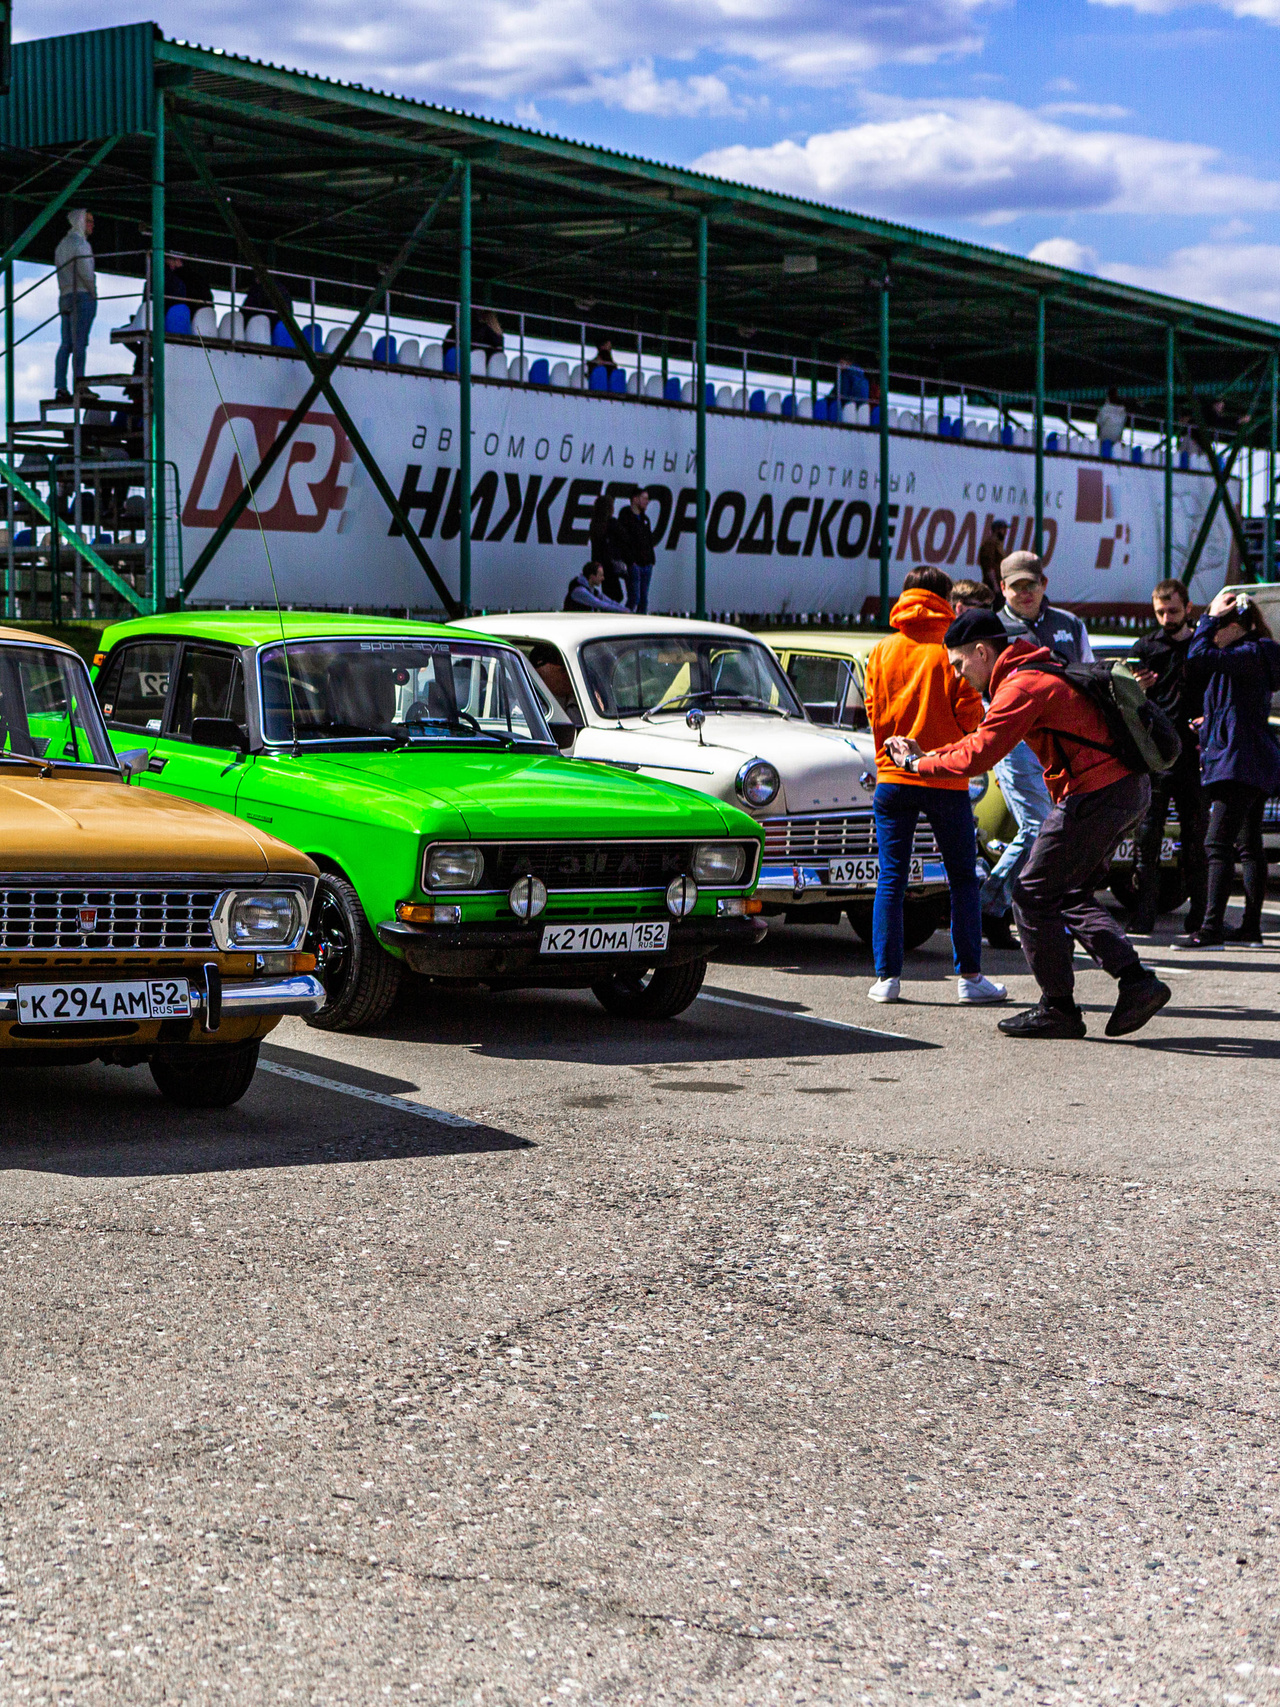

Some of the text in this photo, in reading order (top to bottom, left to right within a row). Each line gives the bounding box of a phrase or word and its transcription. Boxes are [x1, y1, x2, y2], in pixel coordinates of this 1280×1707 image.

[412, 425, 698, 474] авомобильный
[962, 482, 1063, 509] комплкс
[547, 924, 664, 950] К210МА 152
[31, 983, 180, 1019] К294АМ 52
[152, 1006, 173, 1015] RUS
